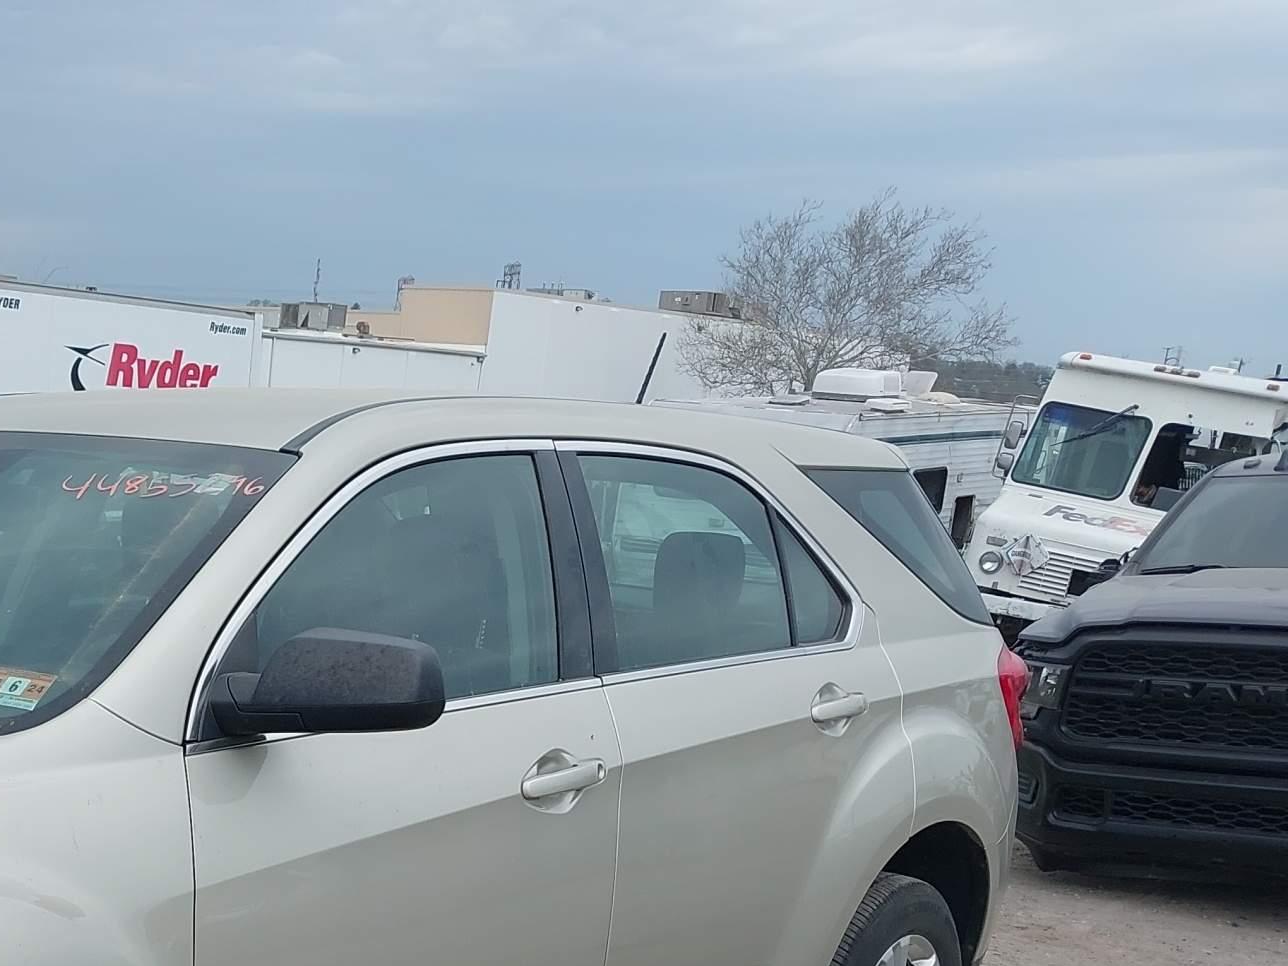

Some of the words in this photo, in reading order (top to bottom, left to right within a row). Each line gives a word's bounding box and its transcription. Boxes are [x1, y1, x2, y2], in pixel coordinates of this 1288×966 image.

[209, 321, 247, 336] Ryder.com
[106, 342, 219, 389] Ryder
[8, 680, 22, 692] 6
